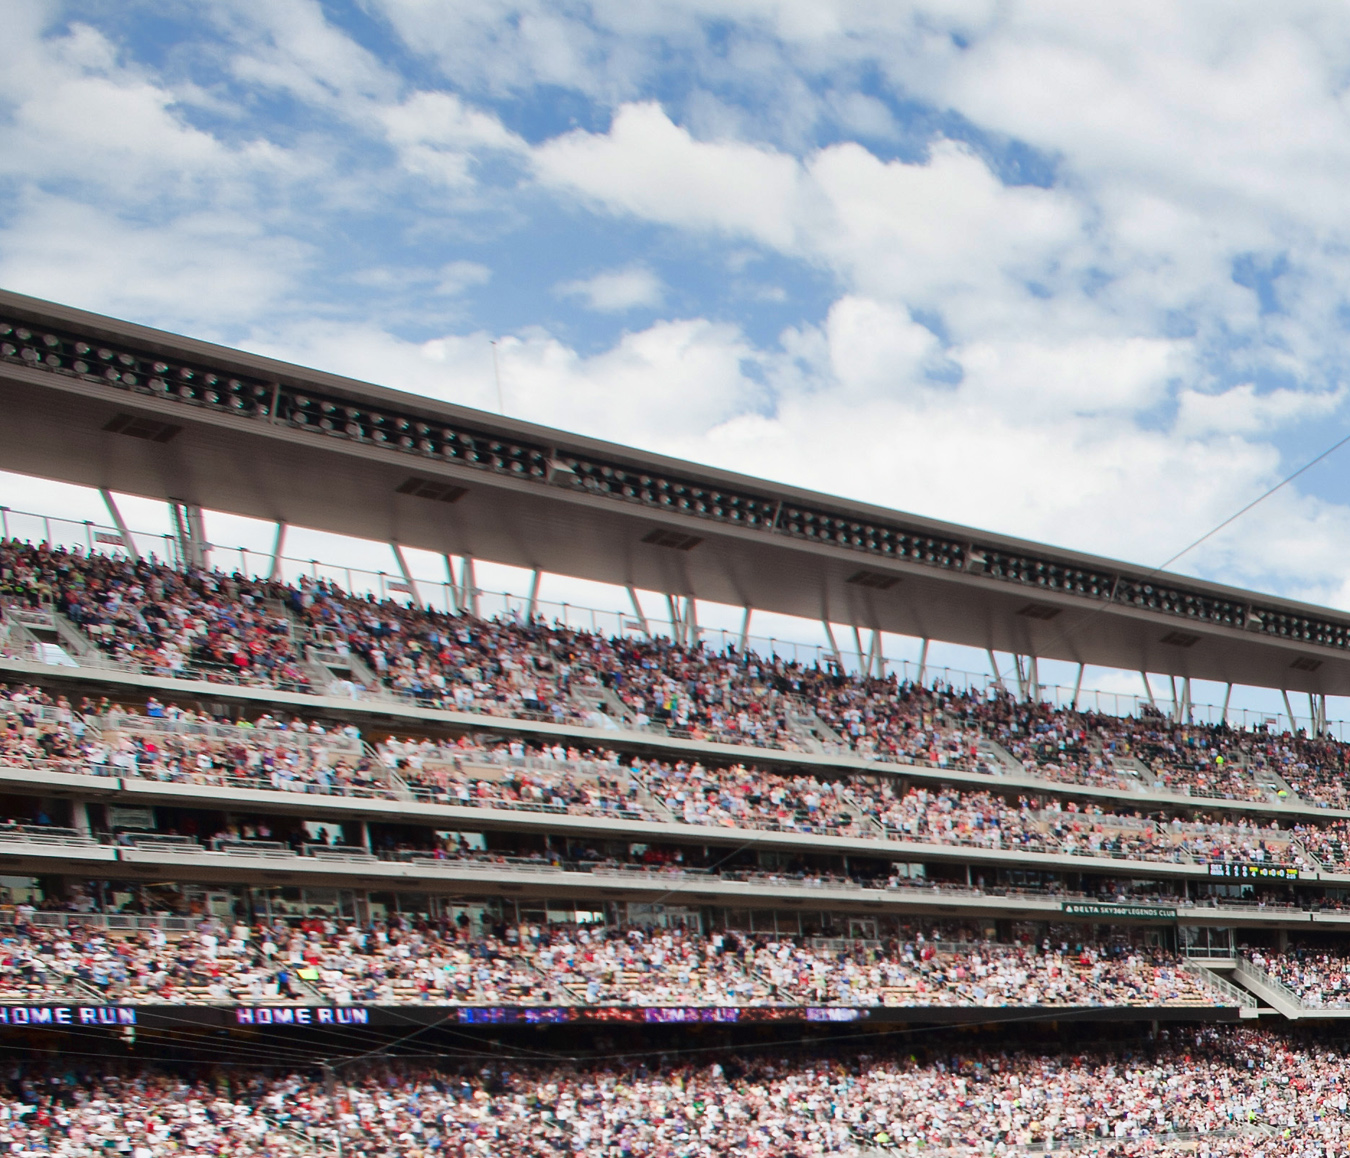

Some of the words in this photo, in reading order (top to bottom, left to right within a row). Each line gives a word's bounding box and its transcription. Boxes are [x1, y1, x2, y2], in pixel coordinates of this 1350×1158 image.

[80, 1007, 136, 1025] RUN
[236, 1007, 311, 1025] HOME
[317, 1007, 370, 1025] RUN
